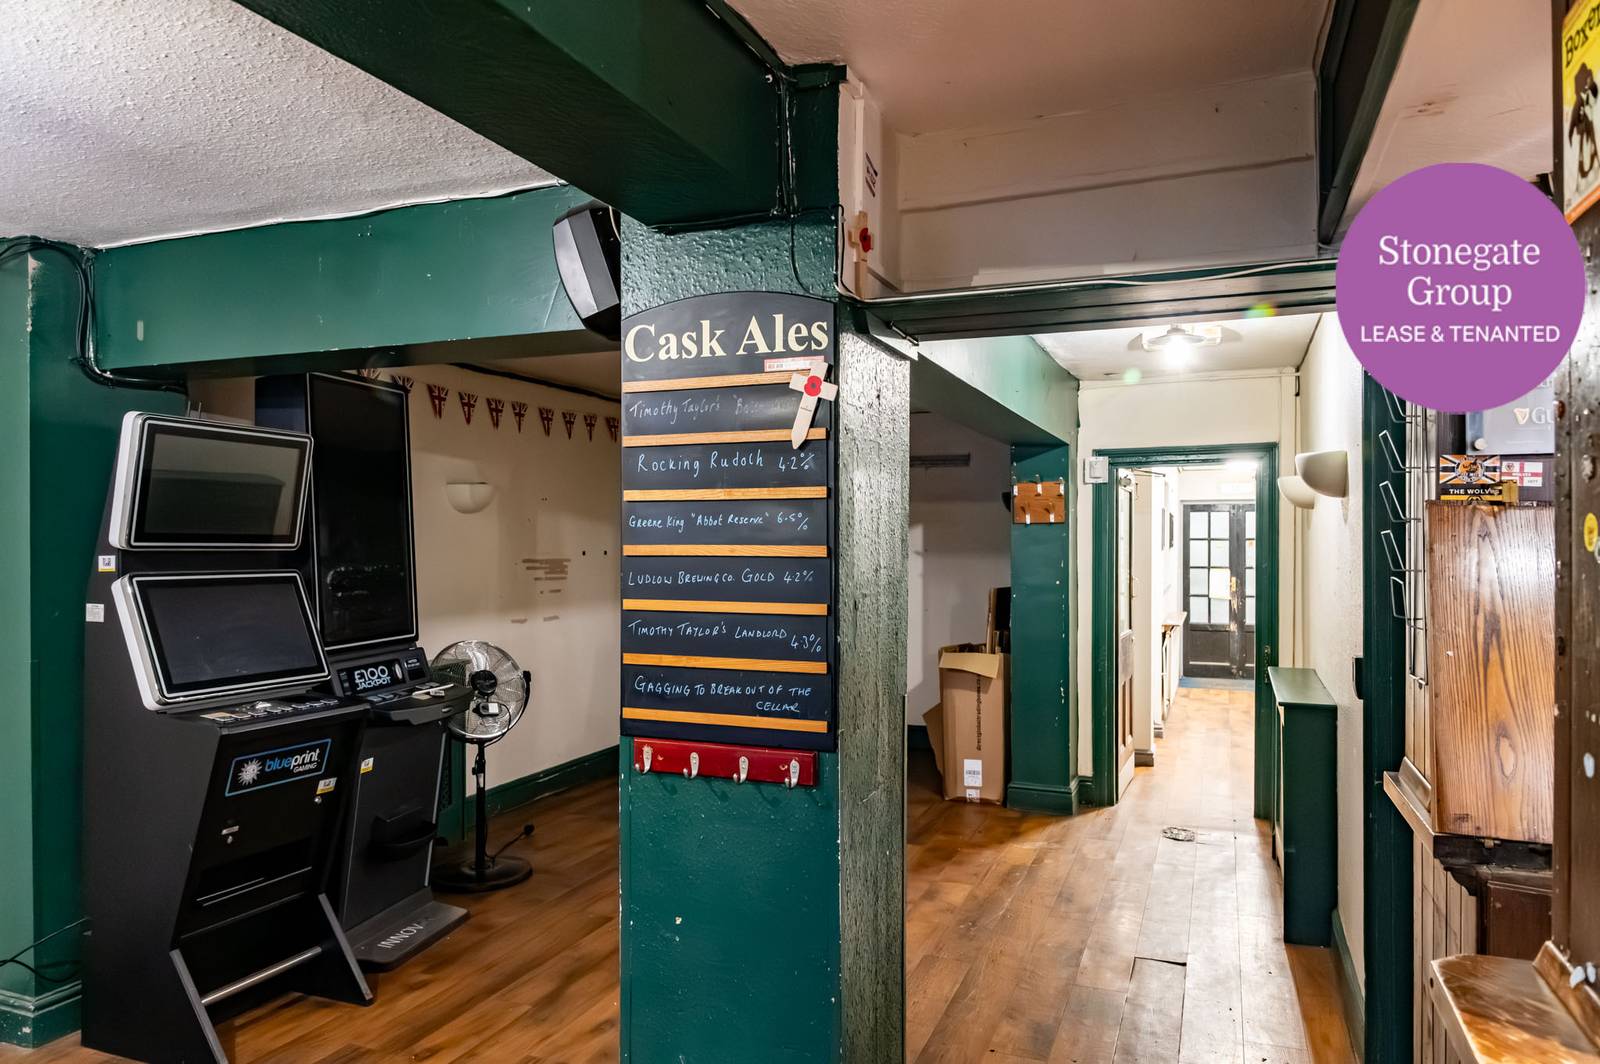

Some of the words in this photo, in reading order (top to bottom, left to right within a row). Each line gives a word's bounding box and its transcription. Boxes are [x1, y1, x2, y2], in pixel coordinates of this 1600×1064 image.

[624, 319, 727, 363] Cask
[736, 313, 829, 355] Ales
[629, 400, 679, 424] Timothy
[637, 453, 700, 477] Rocking
[667, 514, 685, 533] King
[628, 571, 673, 586] LUDLOW
[741, 568, 775, 584] GOLD
[628, 619, 673, 637] TIMOTHY
[677, 621, 727, 636] TAYLOR'S
[735, 625, 788, 640] LANDLORD
[354, 665, 389, 683] £100
[356, 676, 391, 691] JACKPOT
[634, 675, 690, 696] GAGGING
[694, 684, 706, 695] TO
[710, 684, 742, 697] BREAK
[745, 685, 764, 695] OUT
[768, 684, 782, 694] OF
[788, 686, 812, 697] THE
[755, 700, 801, 713] CELLAR
[265, 748, 320, 772] blueprint
[293, 762, 318, 774] GAMING
